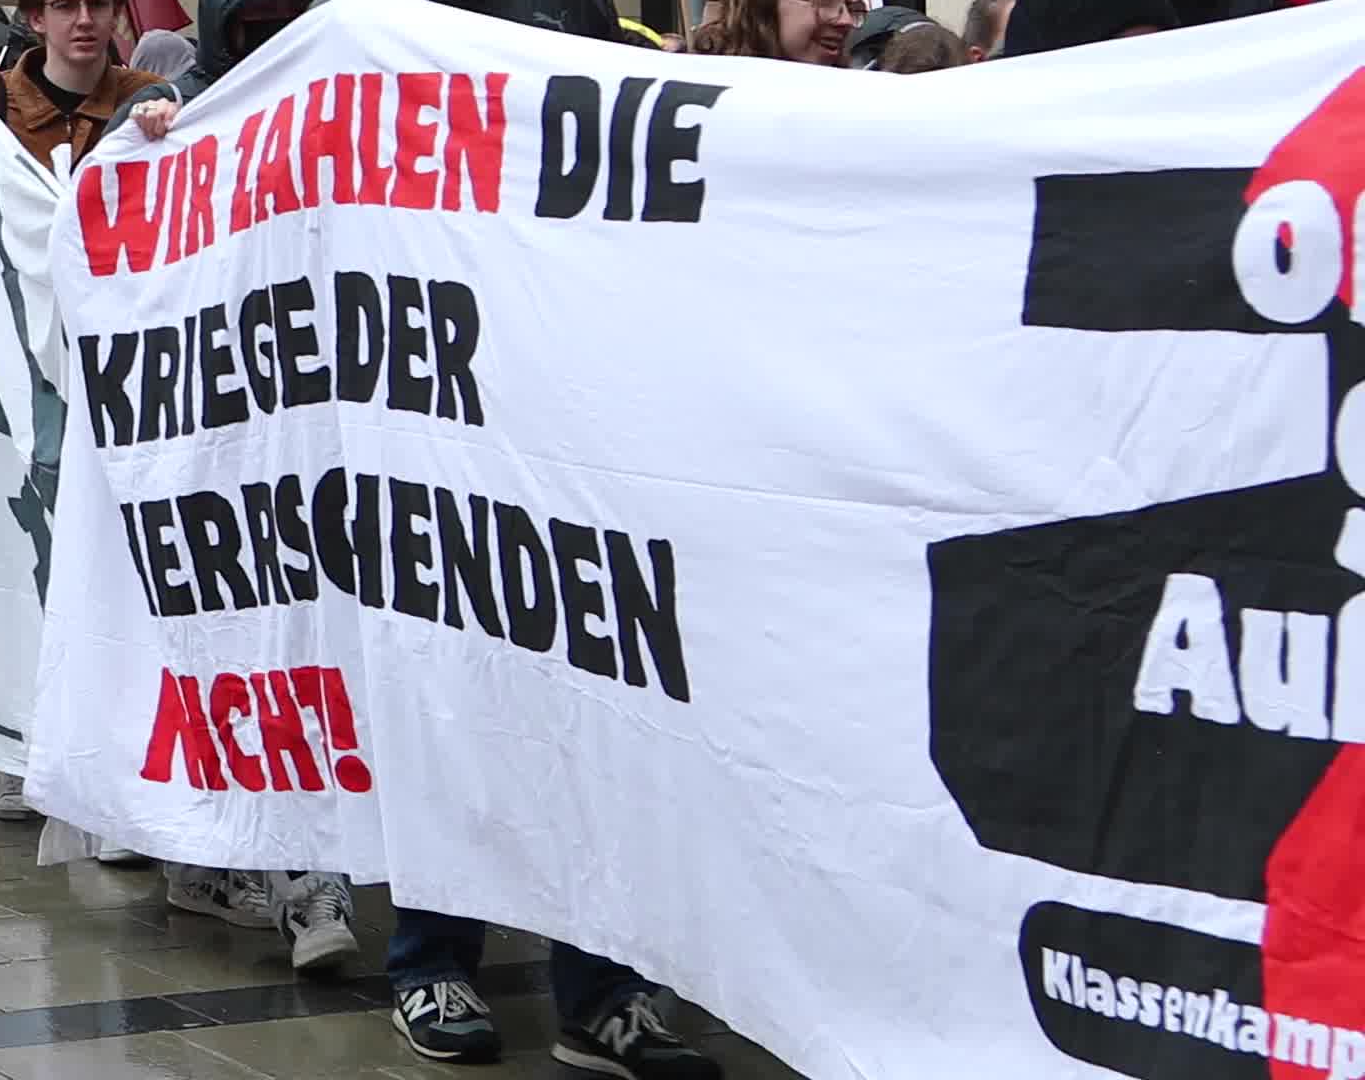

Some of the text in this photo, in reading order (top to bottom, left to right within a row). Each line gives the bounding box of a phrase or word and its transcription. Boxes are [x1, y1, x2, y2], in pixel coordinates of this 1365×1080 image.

[78, 72, 731, 276] WIR ZAHLEN DIE
[81, 271, 485, 447] KRIEGE DER
[1133, 573, 1365, 742] Au
